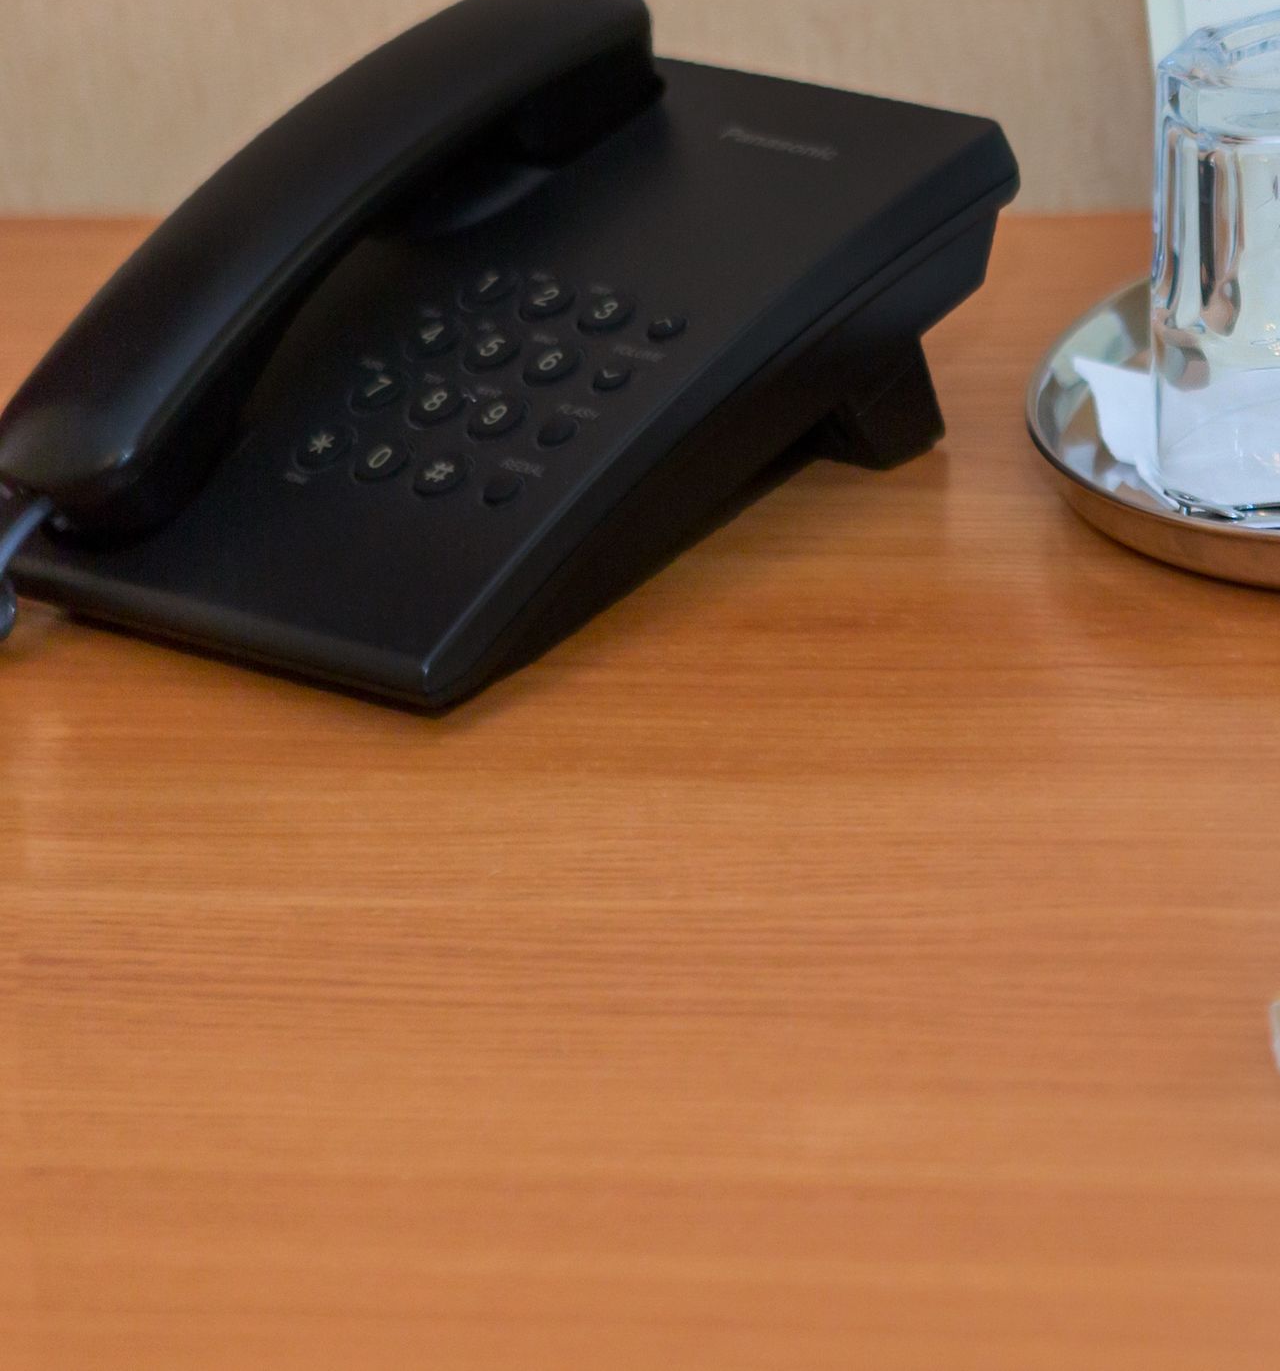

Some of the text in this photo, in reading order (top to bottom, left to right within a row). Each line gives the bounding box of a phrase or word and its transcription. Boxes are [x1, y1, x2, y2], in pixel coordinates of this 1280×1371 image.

[719, 127, 839, 161] Panasonic
[479, 275, 618, 320] 1 2 3
[420, 325, 563, 371] 4 5 6
[366, 376, 508, 425] 7 8 9
[368, 448, 393, 469] 0
